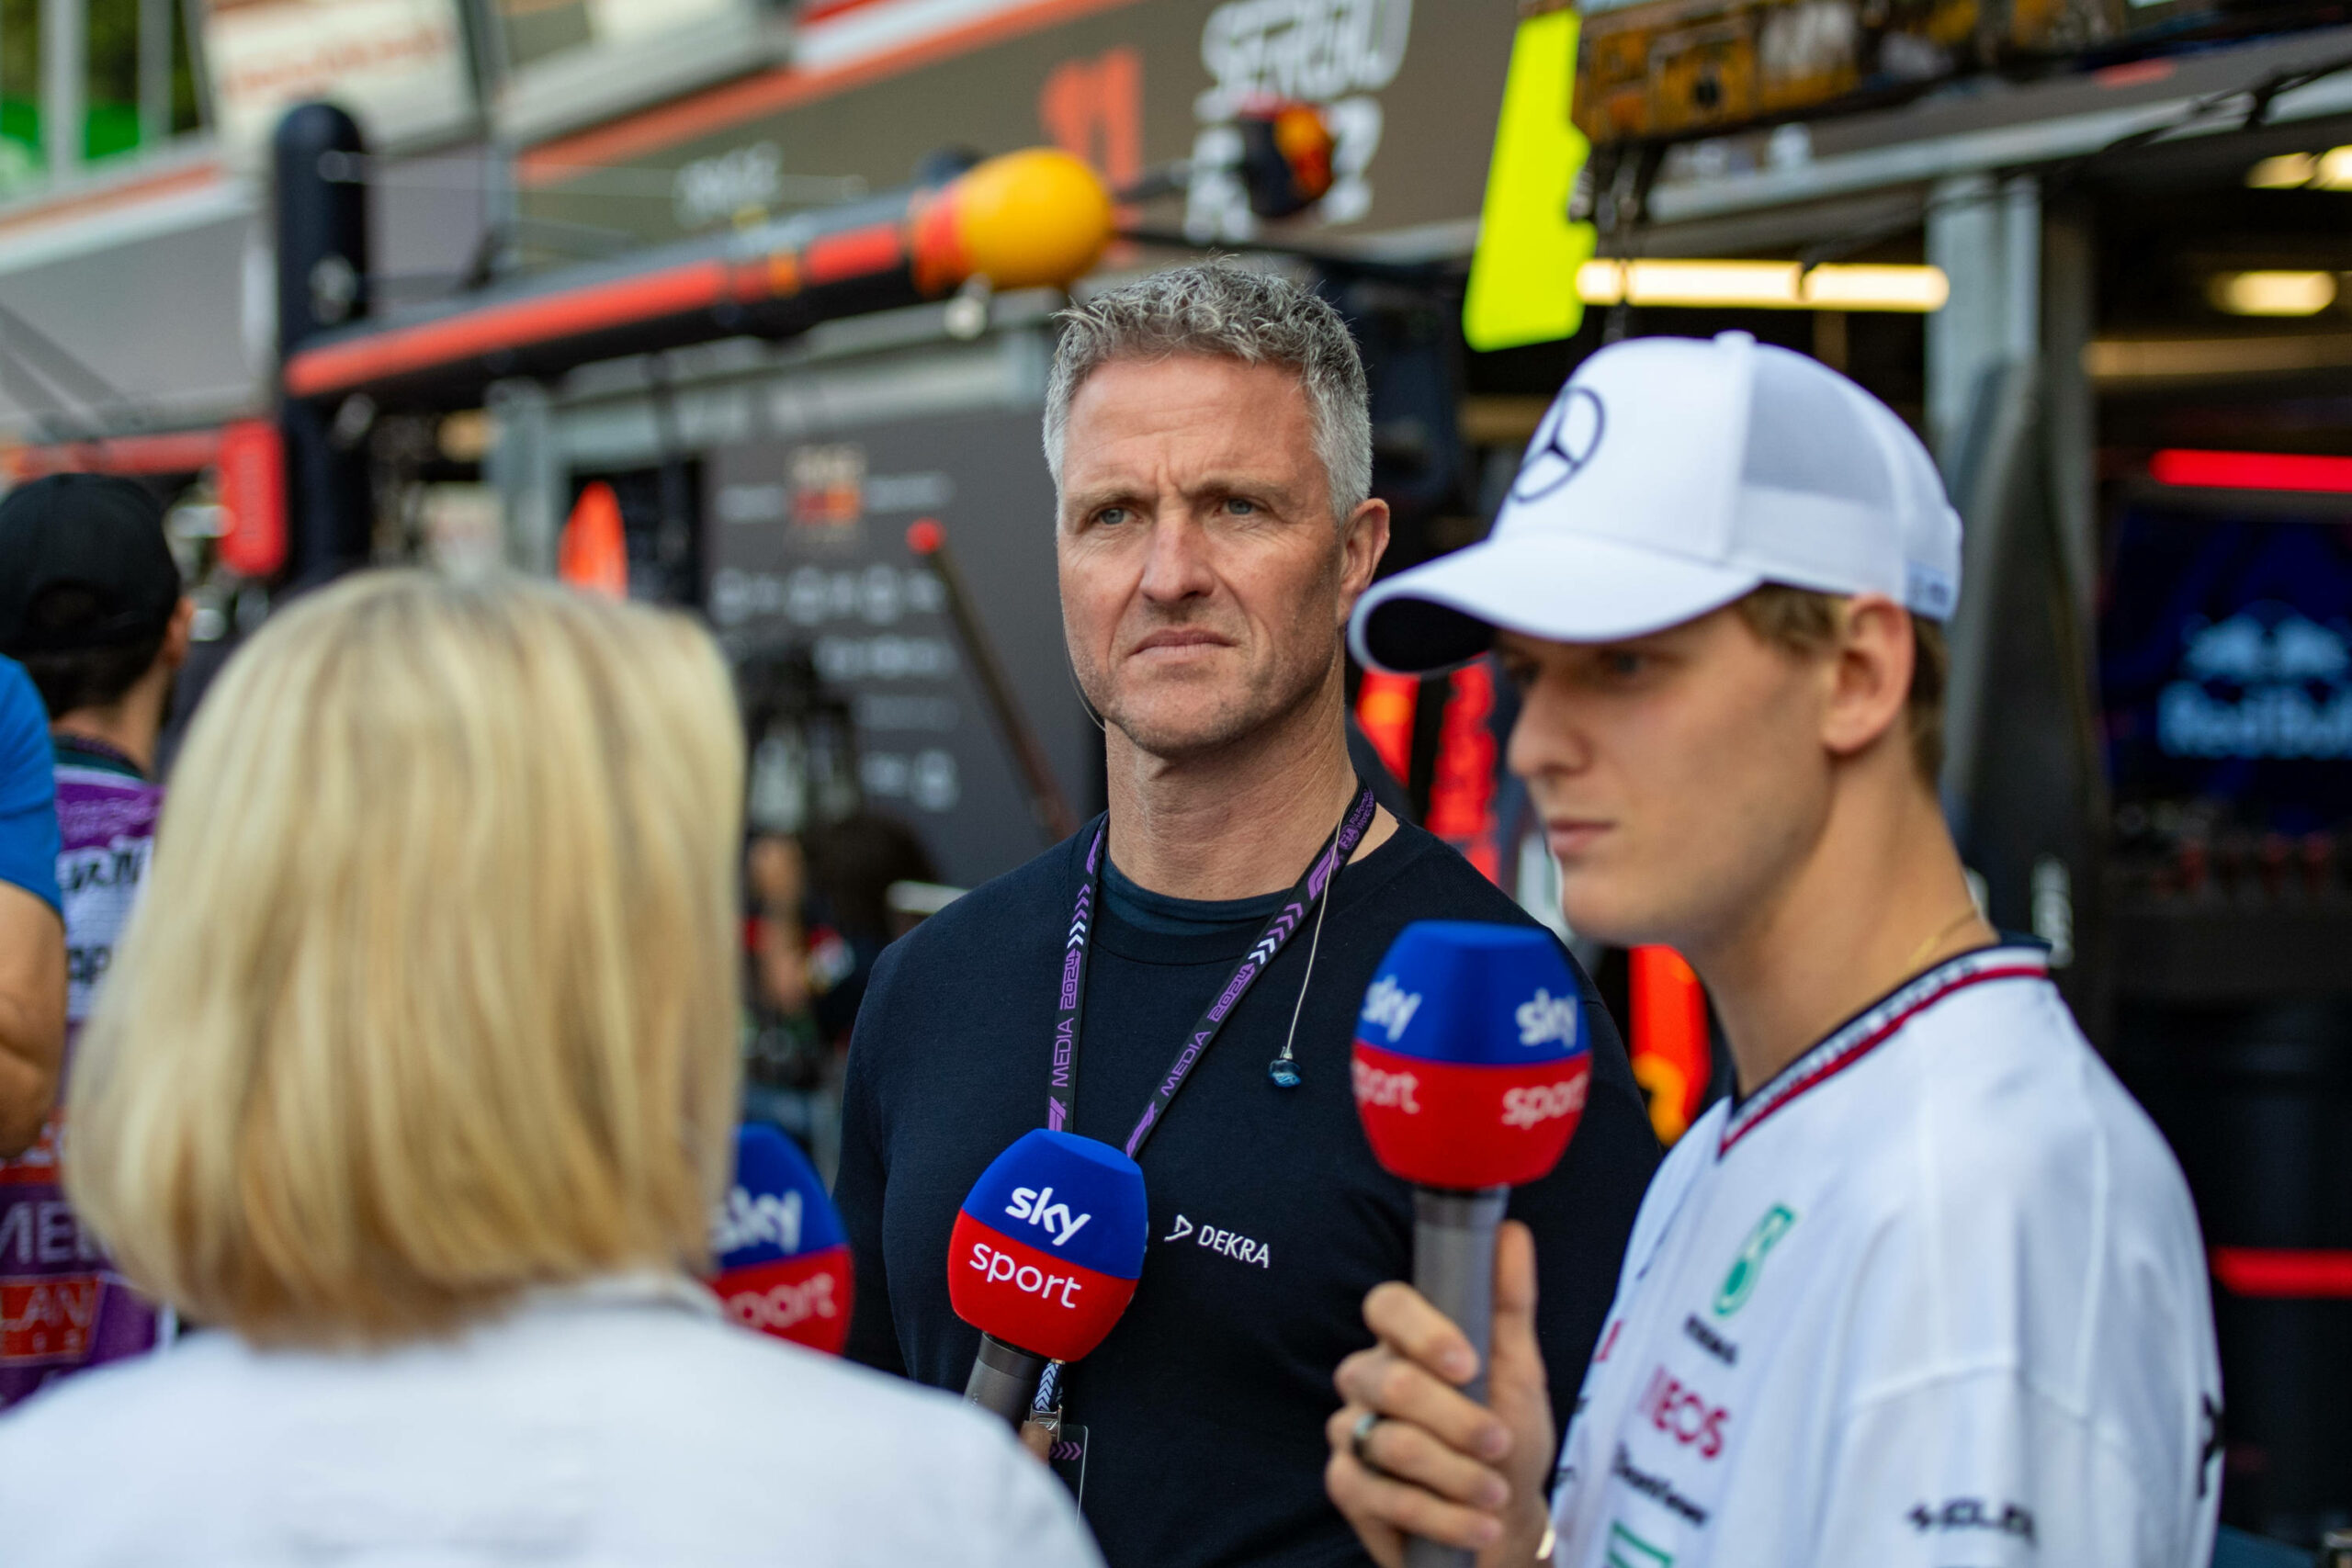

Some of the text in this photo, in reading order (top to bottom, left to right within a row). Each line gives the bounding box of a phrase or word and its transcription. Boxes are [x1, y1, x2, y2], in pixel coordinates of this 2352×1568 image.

[1059, 948, 1081, 1010] 2024
[1362, 974, 1423, 1043] sky
[1051, 1017, 1075, 1087] MEDIA
[1159, 1030, 1212, 1097] MEDIA
[1206, 963, 1256, 1022] 2024
[1004, 1187, 1091, 1247] sky
[1197, 1224, 1270, 1269] DEKRA
[969, 1243, 1082, 1308] sport
